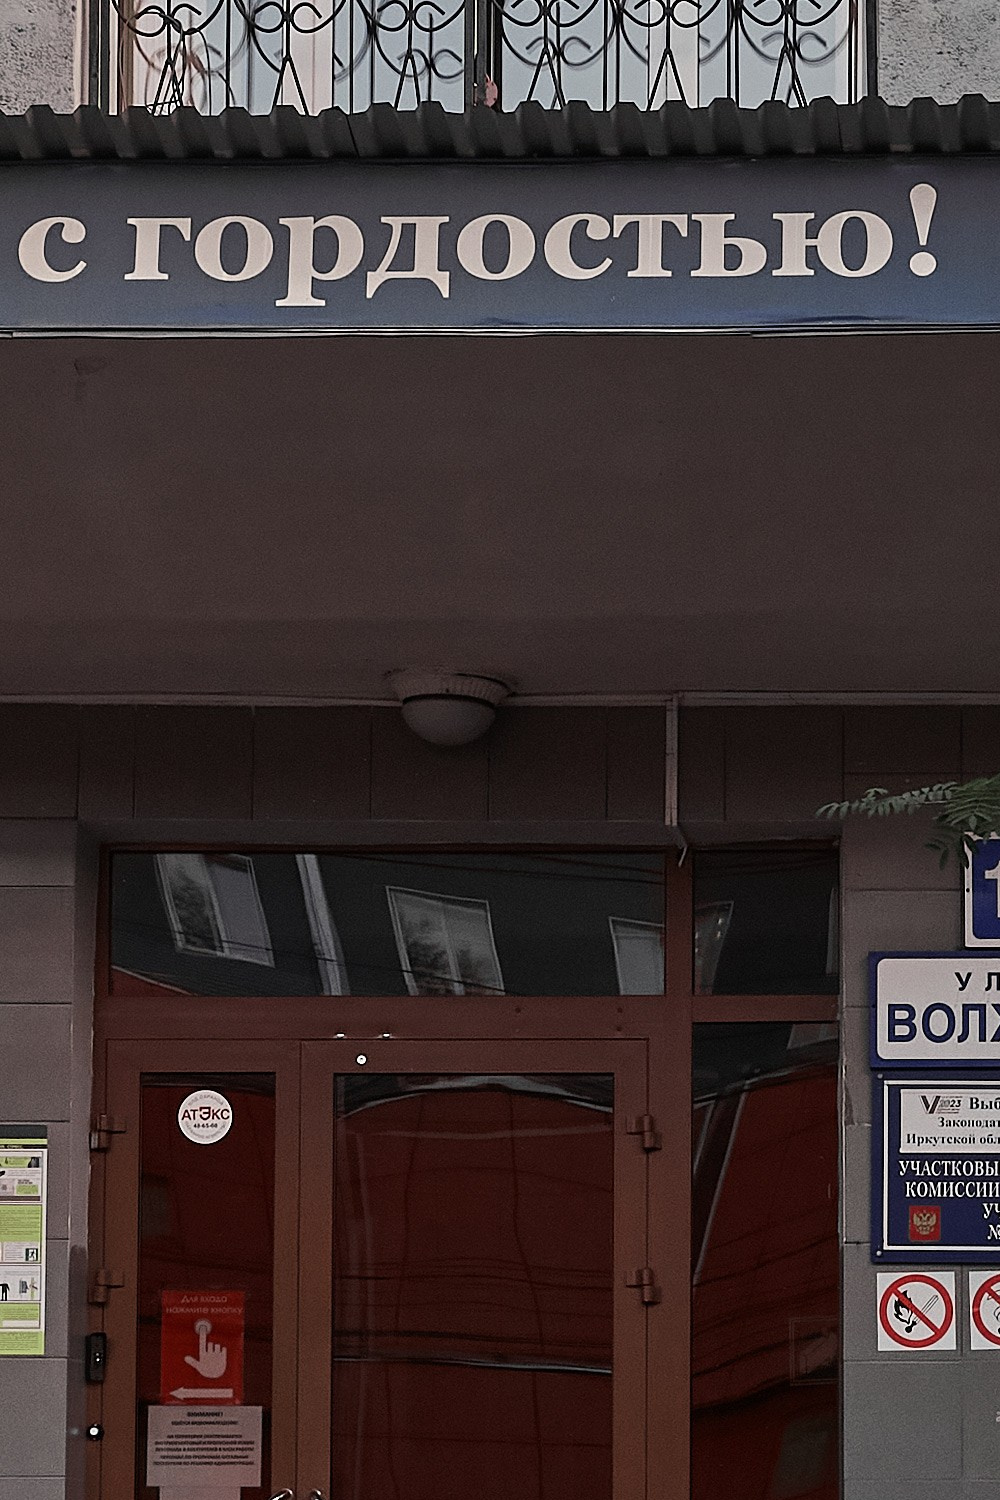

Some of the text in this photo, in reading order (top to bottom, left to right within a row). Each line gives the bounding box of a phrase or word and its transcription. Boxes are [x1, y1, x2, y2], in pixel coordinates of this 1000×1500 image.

[17, 183, 938, 307] с гордостью!
[181, 1106, 230, 1121] АТЭКС
[906, 1133, 975, 1147] Иркутской
[905, 1181, 1000, 1198] КОМИССИИ
